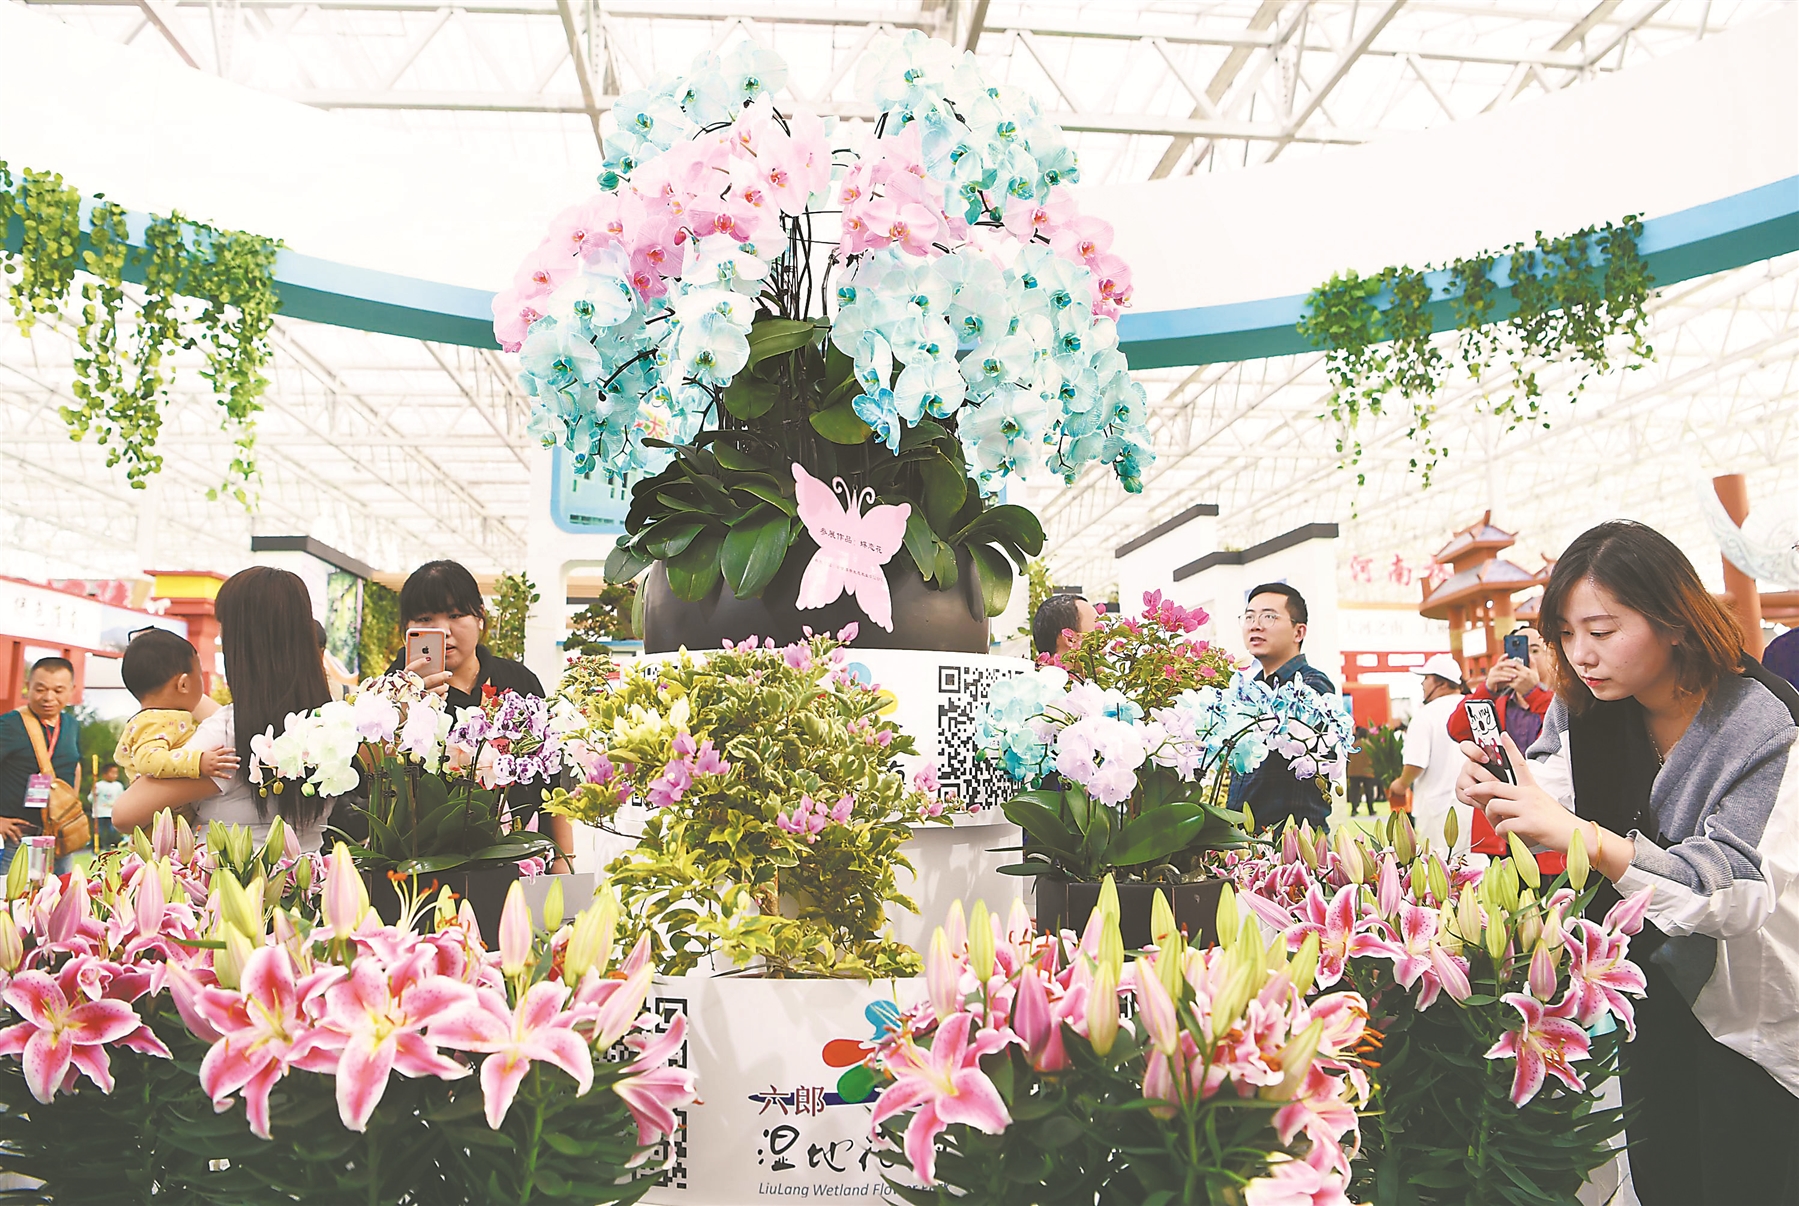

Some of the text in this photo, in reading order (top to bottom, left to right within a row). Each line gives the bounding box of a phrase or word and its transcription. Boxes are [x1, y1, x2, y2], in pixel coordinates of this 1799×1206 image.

[759, 1085, 825, 1116] 六郎
[759, 1183, 809, 1197] LiuLang
[813, 1183, 869, 1196] Wetland
